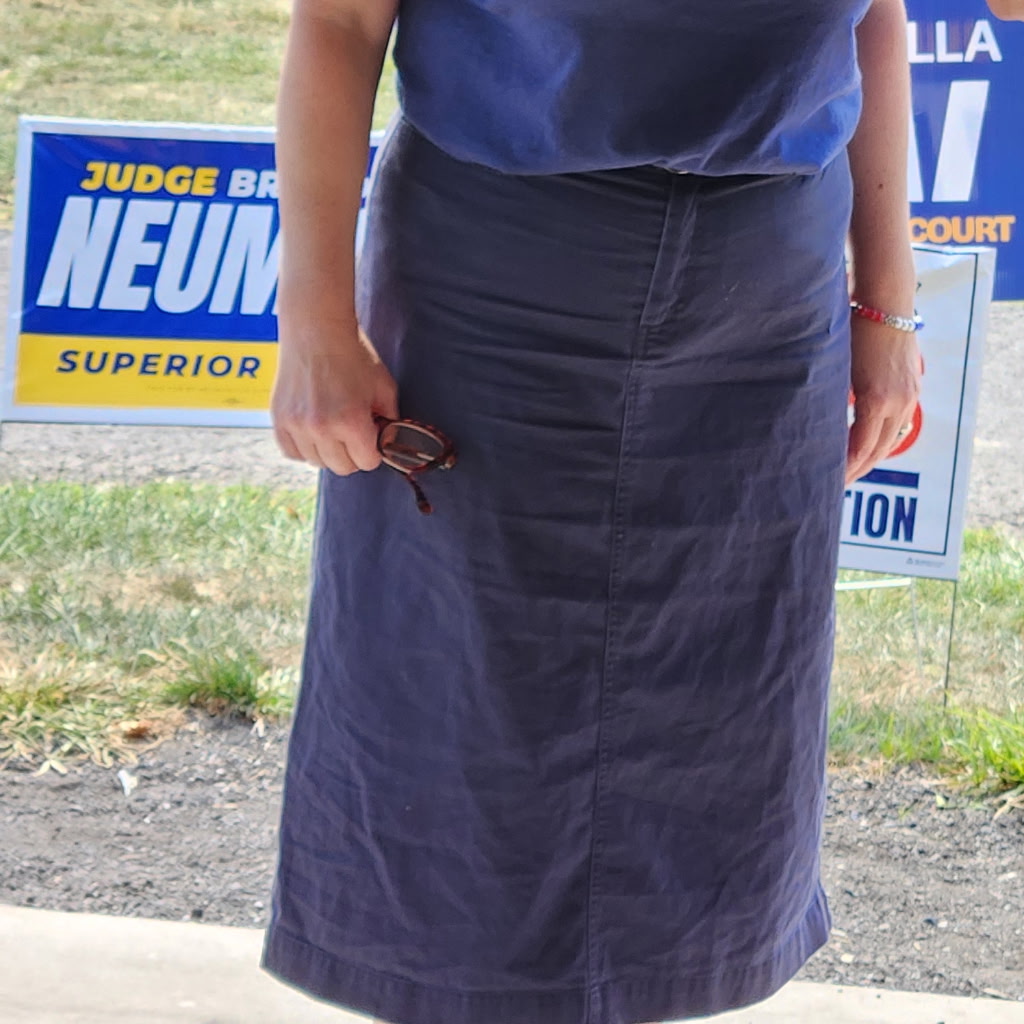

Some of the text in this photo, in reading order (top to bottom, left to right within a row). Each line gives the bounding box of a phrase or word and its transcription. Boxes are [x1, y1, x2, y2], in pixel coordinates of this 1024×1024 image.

[80, 161, 220, 196] JUDGE
[909, 215, 1016, 244] COURT
[56, 349, 262, 379] SUPERIOR
